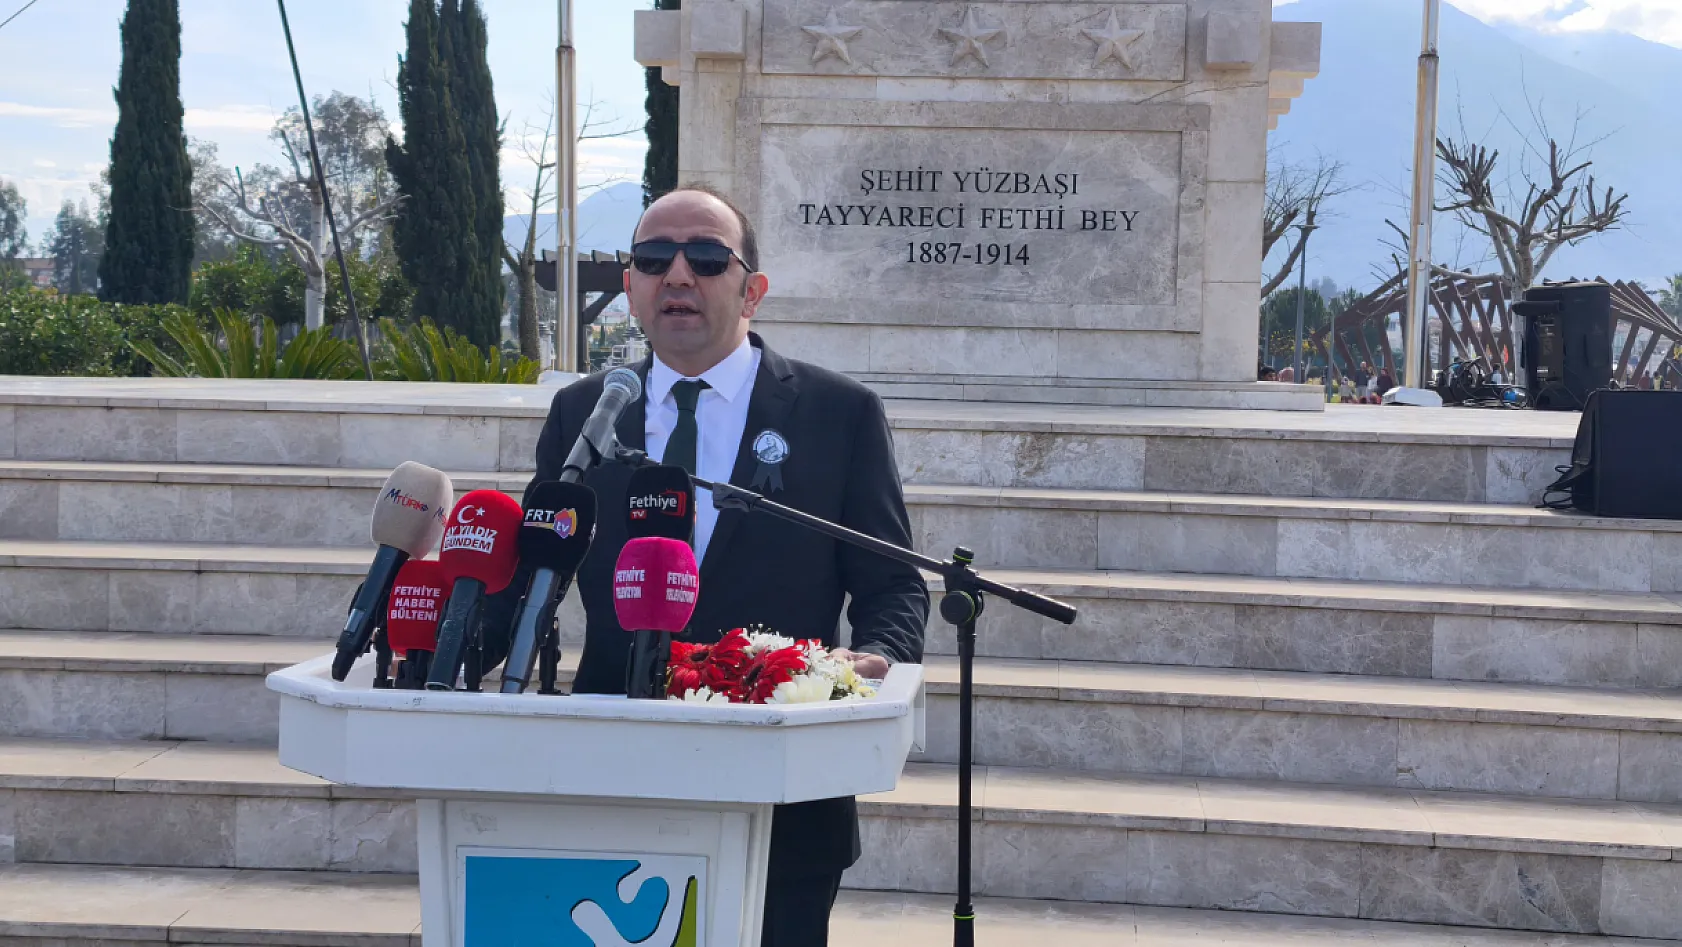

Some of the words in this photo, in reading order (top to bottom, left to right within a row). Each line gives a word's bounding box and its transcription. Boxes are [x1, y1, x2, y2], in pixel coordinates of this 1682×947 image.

[860, 167, 943, 196] ŞEHİT
[952, 166, 1079, 199] YÜZBAŞI
[800, 203, 966, 229] TAYYARECİ
[980, 205, 1066, 231] FETHİ
[1080, 209, 1140, 232] BEY
[906, 242, 1030, 266] 1887-1914
[629, 494, 678, 511] Fethiye
[524, 508, 555, 522] FRT
[556, 520, 570, 533] tv
[459, 525, 498, 539] YILDIZ
[616, 566, 646, 583] FETHİYE
[667, 570, 697, 588] FETHİYE
[394, 585, 441, 597] FETHİYE
[395, 598, 435, 609] HABER
[390, 608, 439, 621] BÜLTENİ
